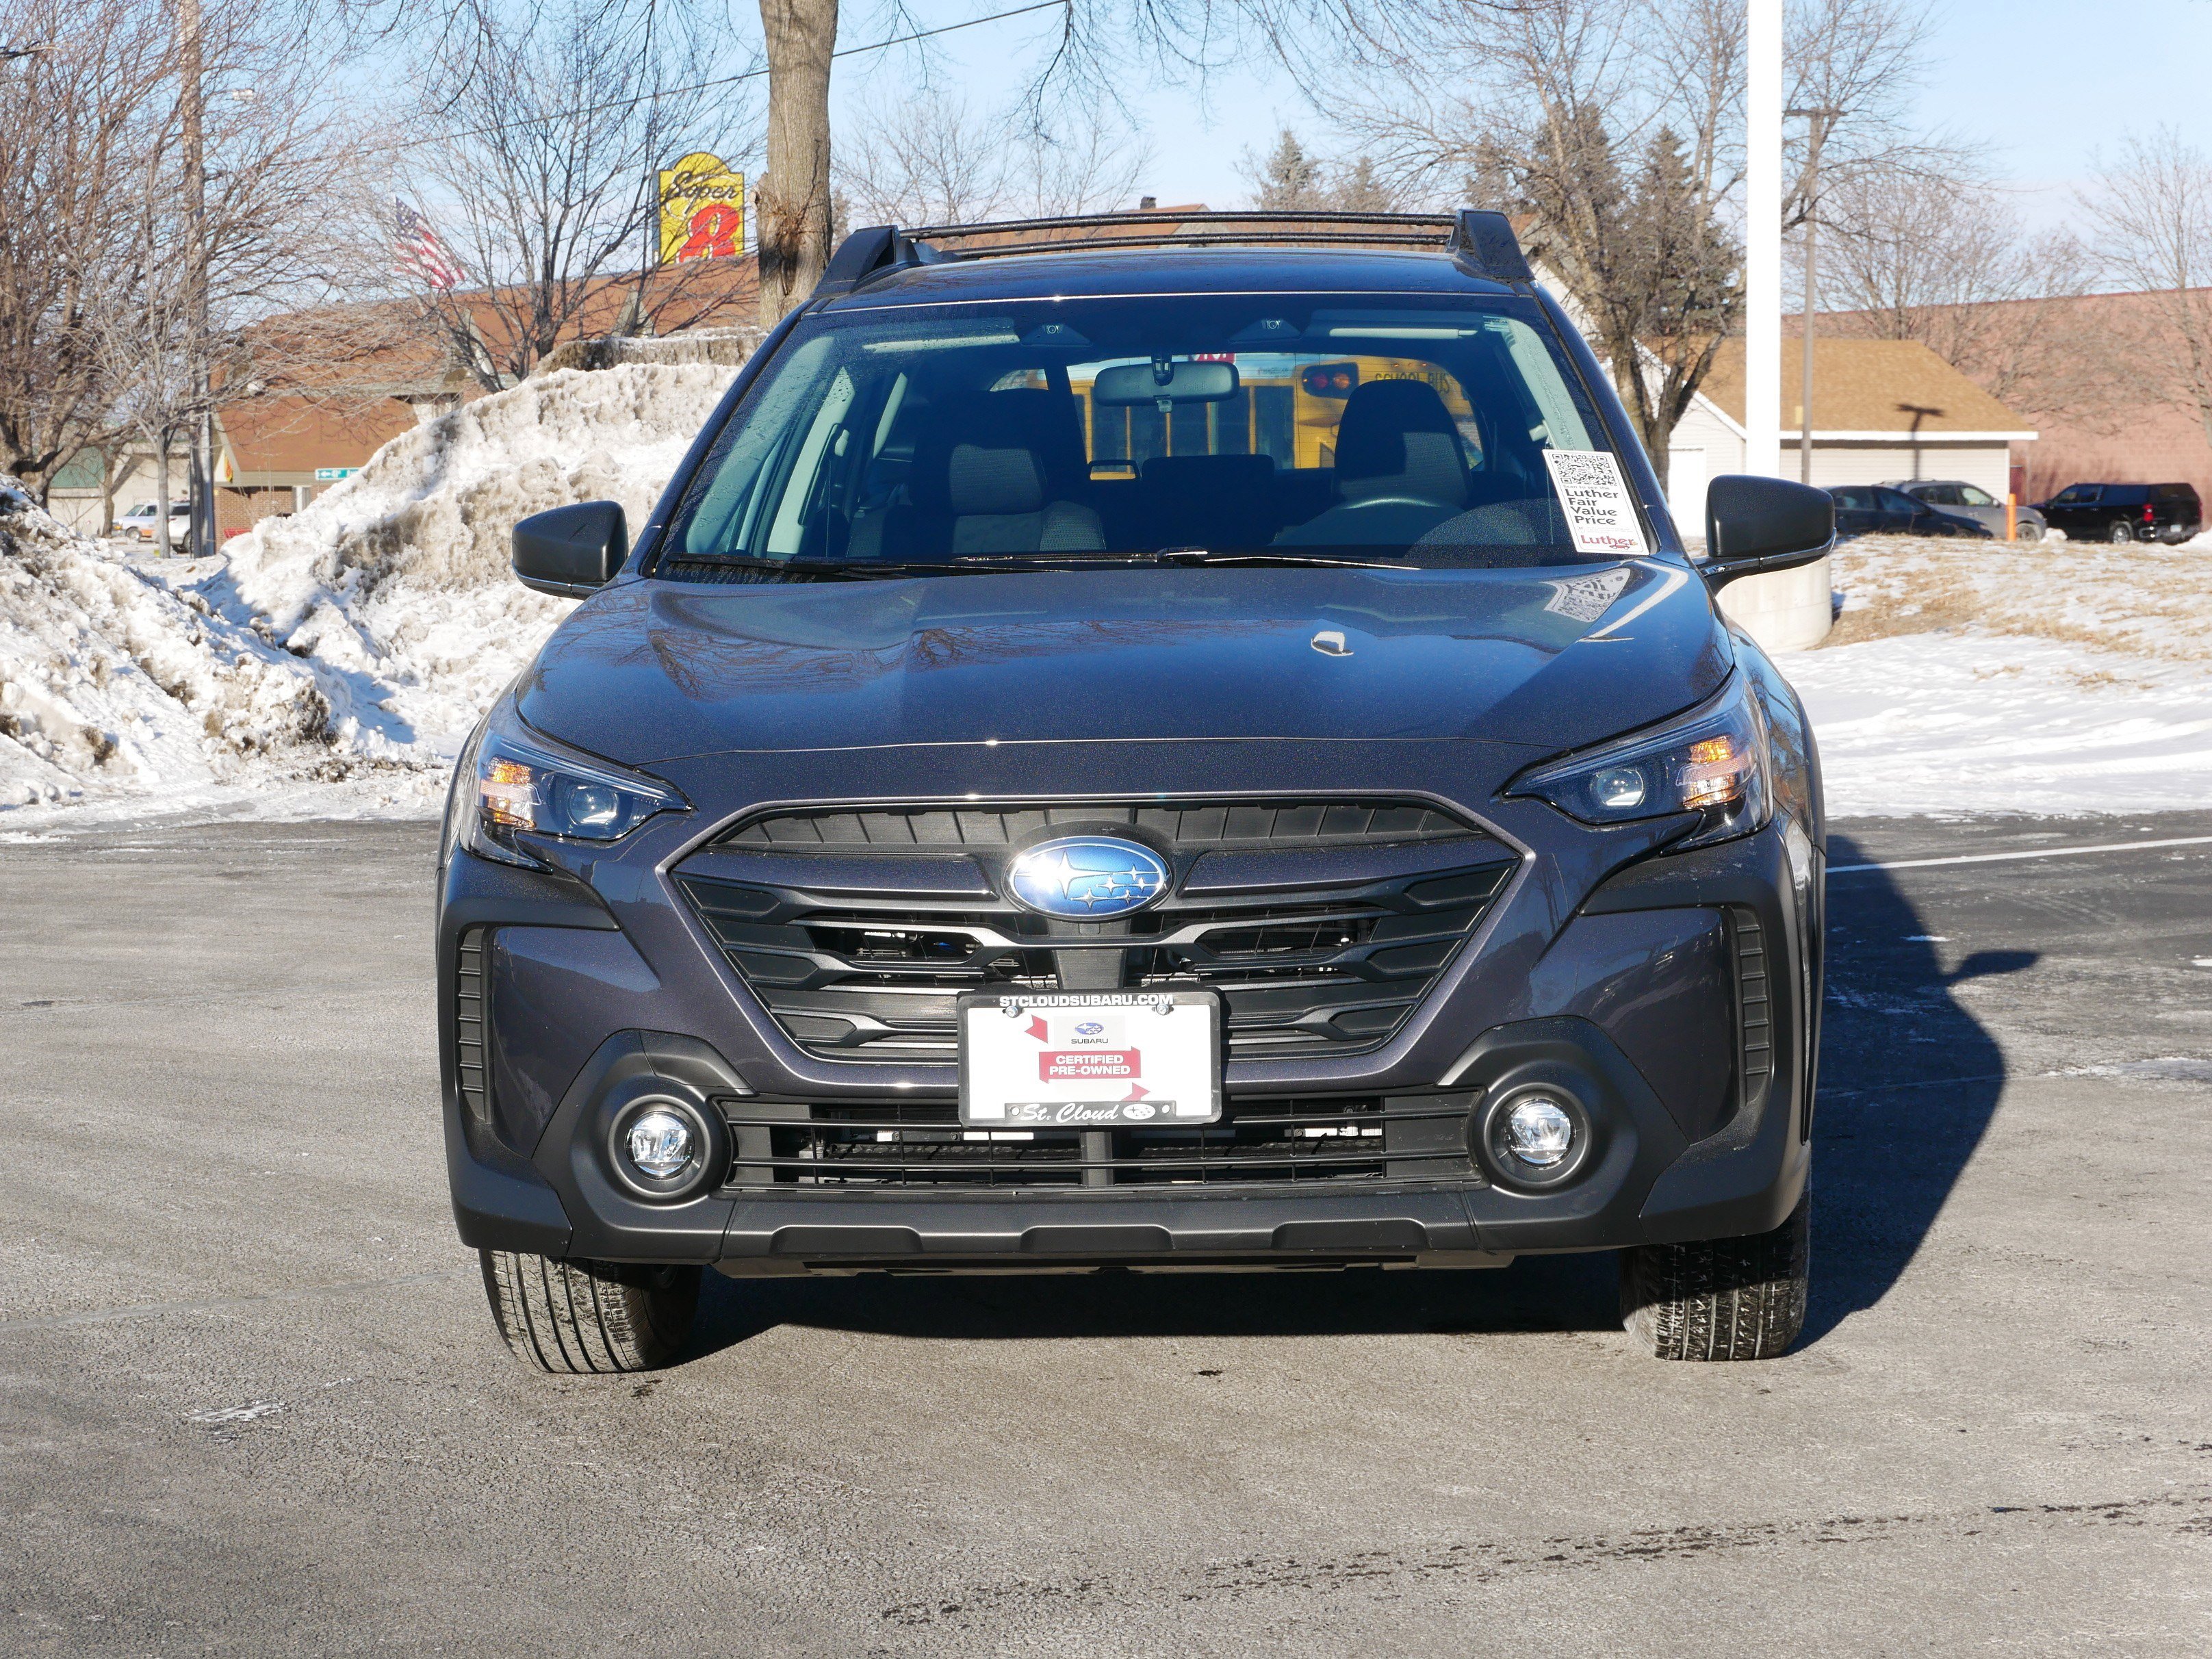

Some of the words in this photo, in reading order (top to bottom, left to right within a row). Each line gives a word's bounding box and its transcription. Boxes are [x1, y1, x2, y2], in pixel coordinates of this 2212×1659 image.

[1565, 489, 1619, 498] Luther
[1568, 498, 1597, 506] Fair
[1570, 506, 1618, 516] Value
[1574, 515, 1617, 525] Price
[1580, 535, 1634, 545] Luther
[999, 994, 1174, 1007] STCLOUDSUBARU.COM
[1055, 1055, 1124, 1065] CERTIFIED
[1049, 1065, 1131, 1075] PRE-OWNED
[1020, 1103, 1051, 1122] St.
[1056, 1103, 1119, 1123] Cloud
